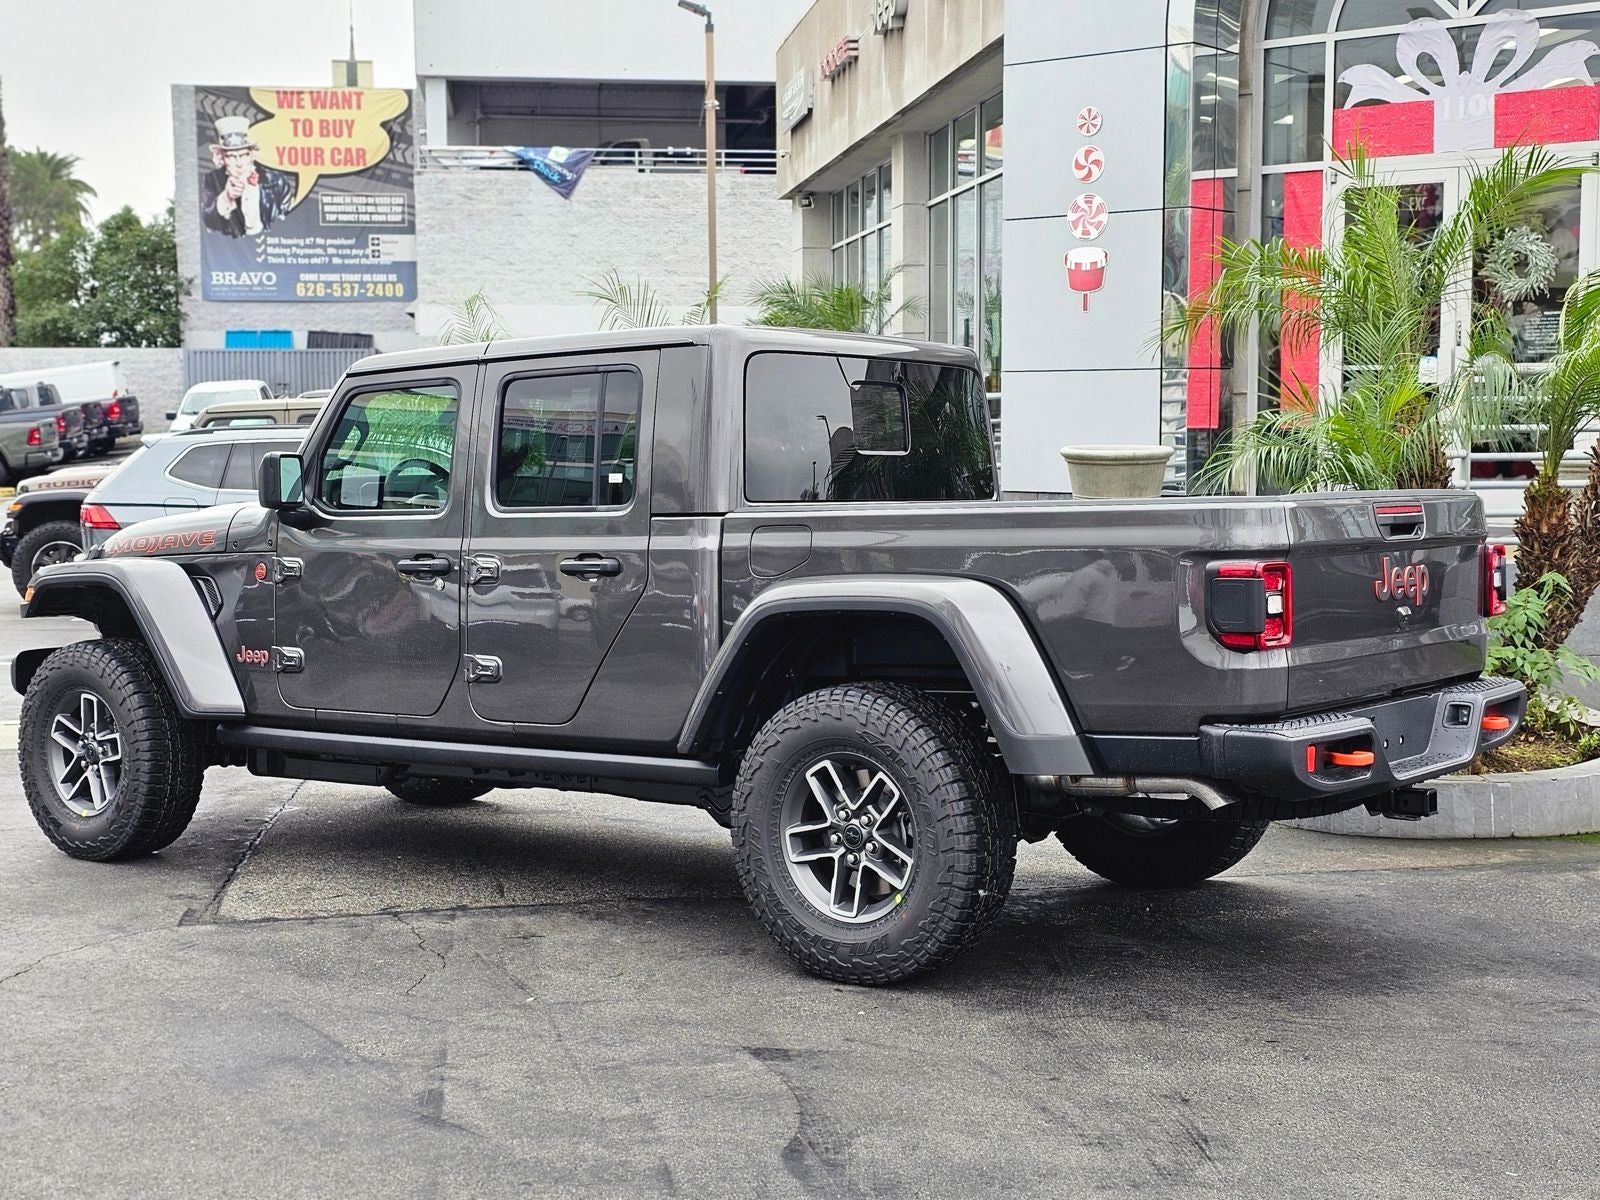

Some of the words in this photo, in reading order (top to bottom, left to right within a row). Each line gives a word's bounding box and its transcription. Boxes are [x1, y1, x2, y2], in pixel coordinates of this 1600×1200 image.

[276, 90, 305, 109] WE
[309, 90, 364, 110] WANT
[1442, 94, 1493, 119] 110
[290, 118, 314, 138] TO
[319, 119, 355, 138] BUY
[276, 147, 325, 166] YOUR
[330, 148, 367, 167] CAR
[210, 271, 277, 285] BRAVO
[296, 282, 404, 298] 626-537-2400
[106, 529, 216, 555] MOJAVE
[1373, 555, 1430, 607] Jeep
[236, 645, 269, 667] Jeep
